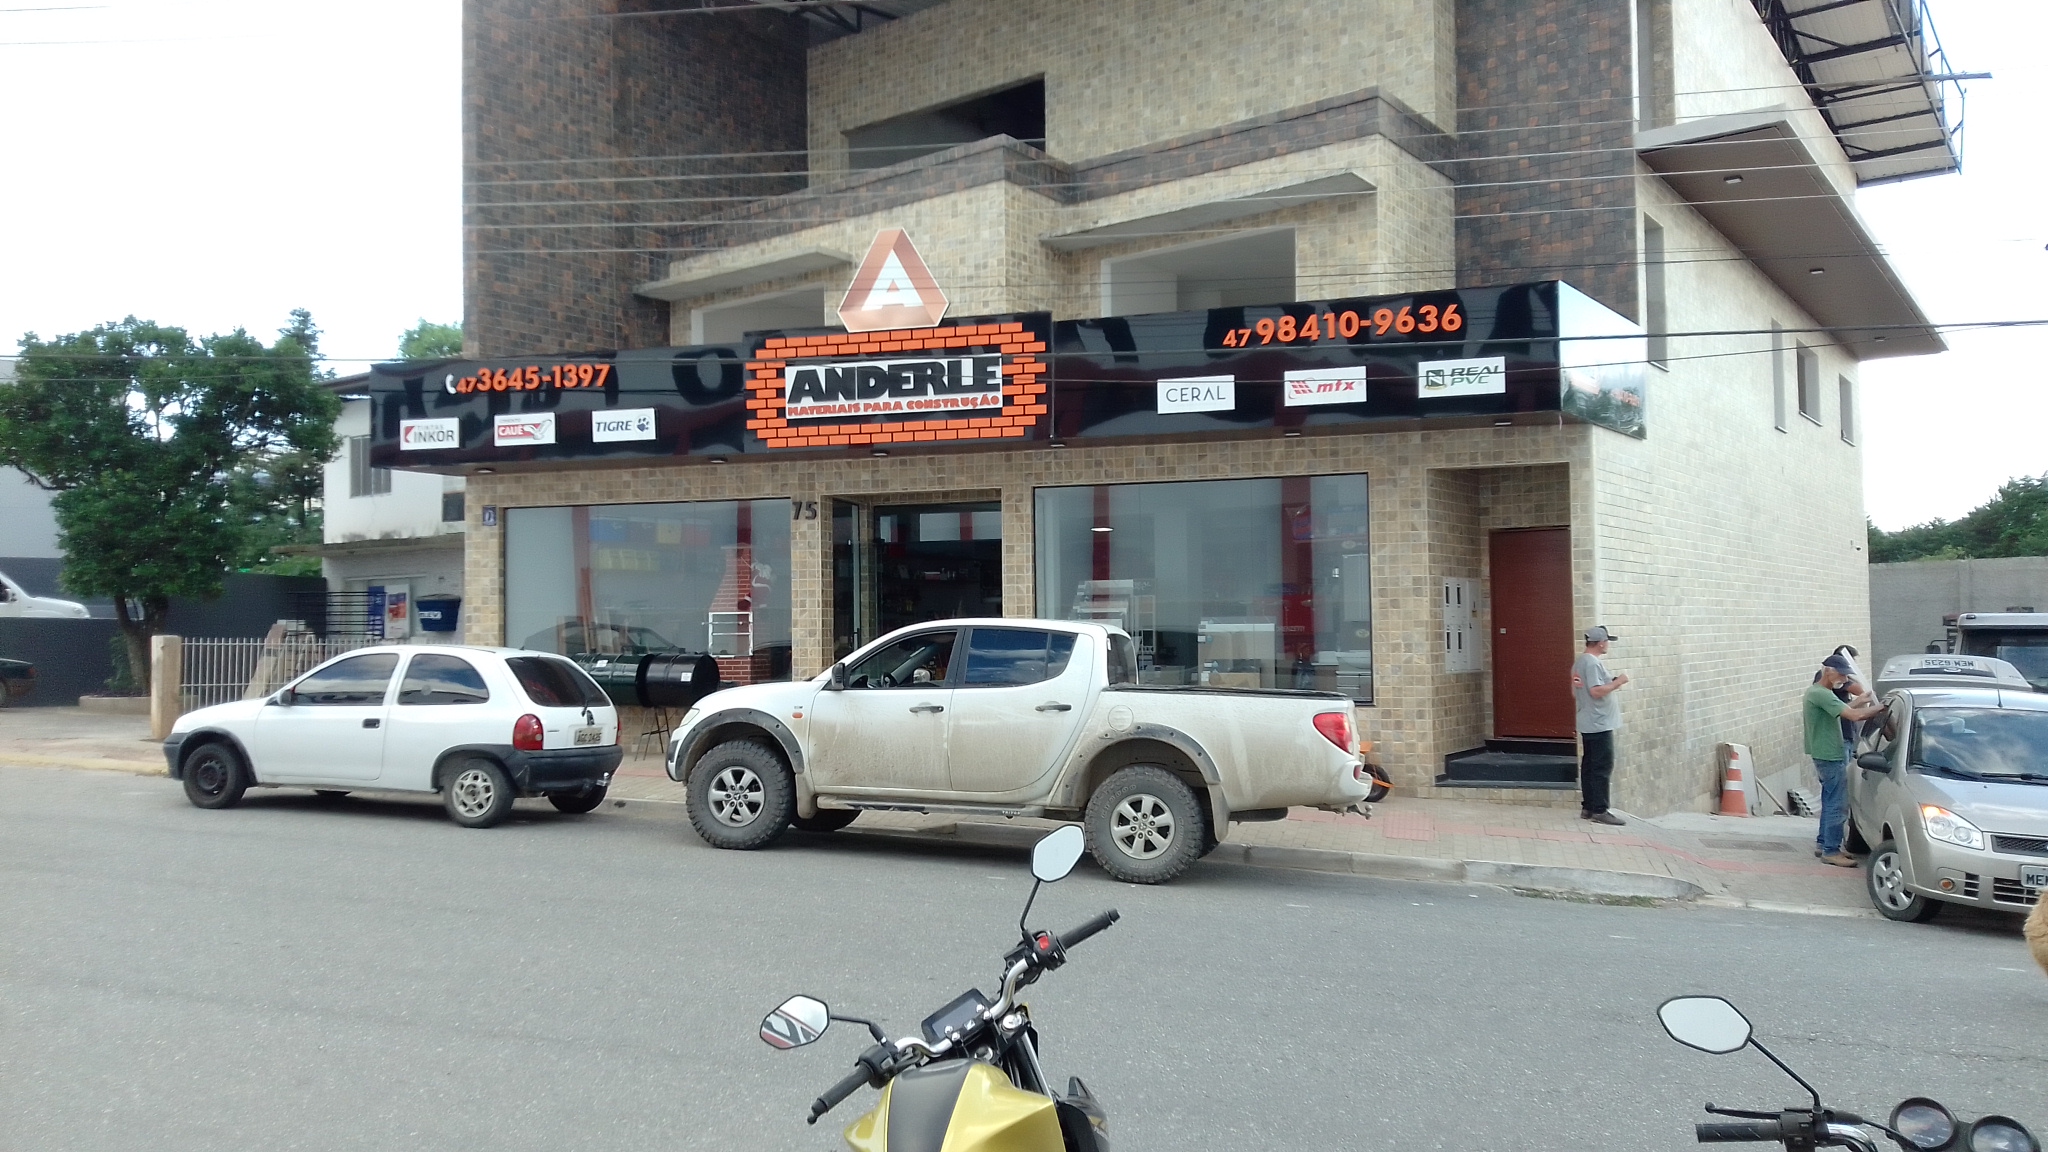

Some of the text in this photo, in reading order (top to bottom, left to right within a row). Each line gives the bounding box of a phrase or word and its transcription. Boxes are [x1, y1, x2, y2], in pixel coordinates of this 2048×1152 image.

[1222, 303, 1463, 347] 47 98410-9636
[456, 363, 611, 394] 47 3645-1397
[1450, 365, 1499, 377] REAL
[787, 357, 1001, 404] ANDERLE
[1450, 375, 1490, 386] PVC
[1165, 385, 1227, 403] CERAL
[787, 394, 1000, 417] MATERIAIS PARA CONSTRUÇÃO
[595, 420, 633, 433] TIGRE
[413, 430, 455, 443] INKOR
[792, 501, 818, 520] 75
[2026, 873, 2048, 886] ME
